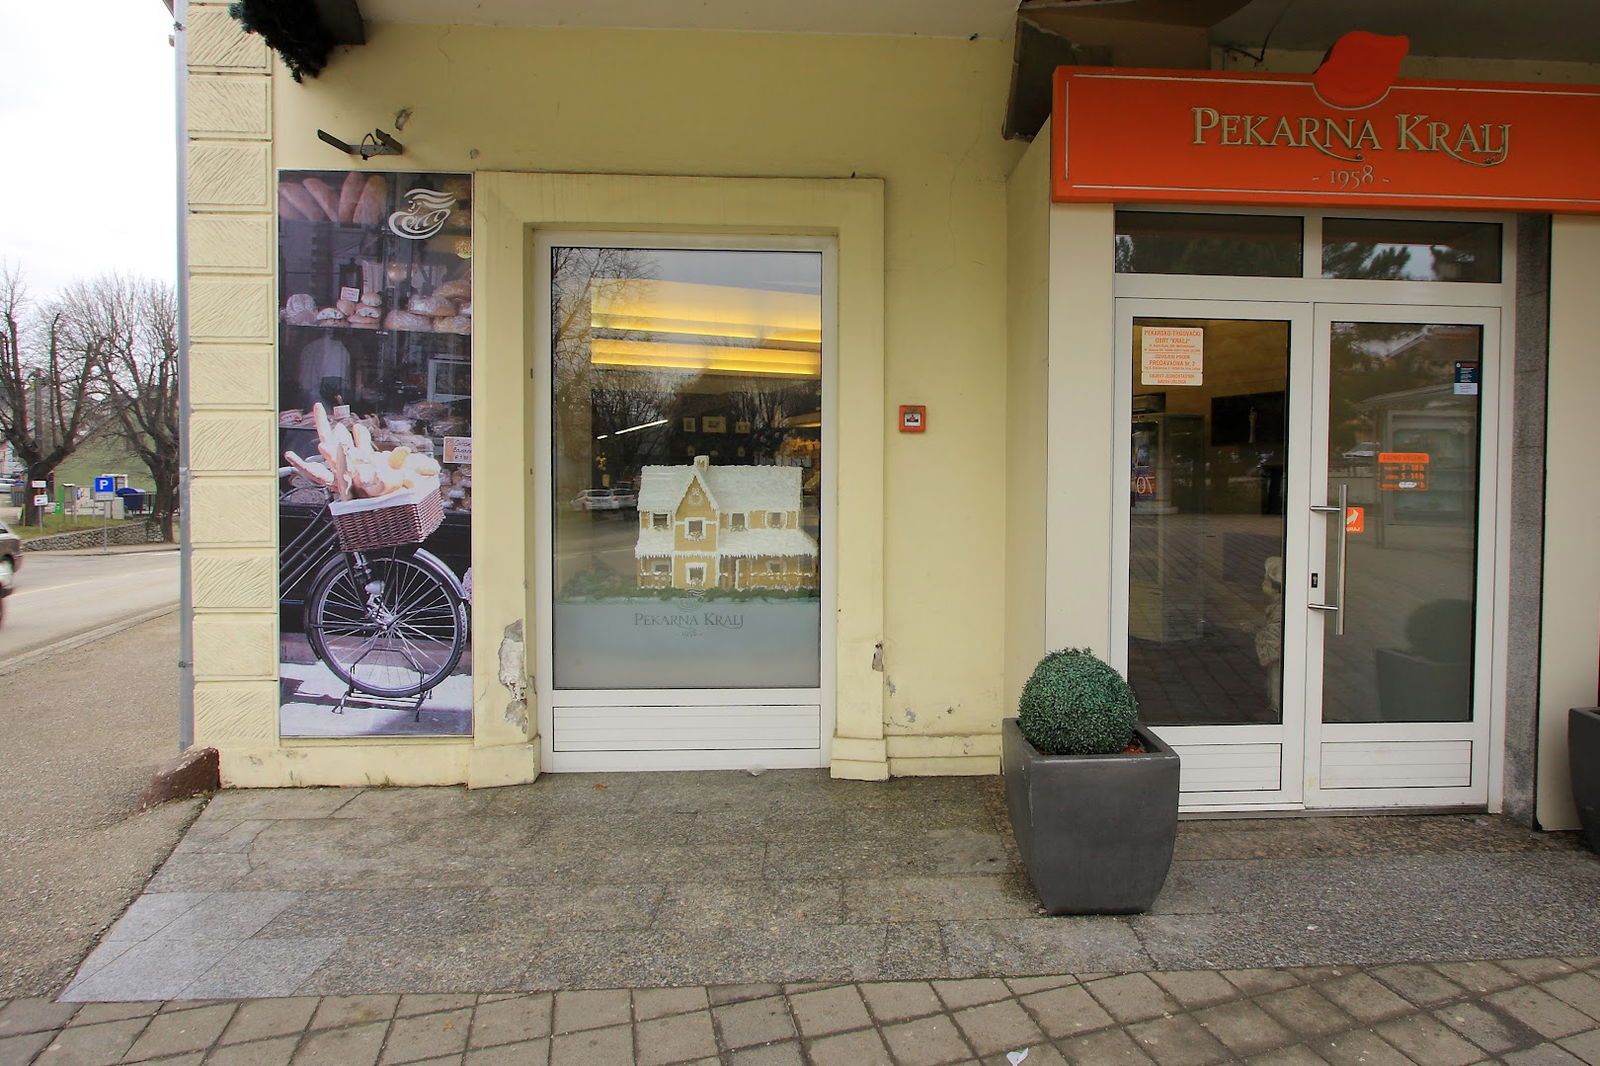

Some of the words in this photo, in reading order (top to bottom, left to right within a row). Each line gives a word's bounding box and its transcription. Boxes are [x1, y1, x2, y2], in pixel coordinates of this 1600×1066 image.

[1191, 107, 1383, 162] PEKARNA
[1395, 113, 1512, 167] KRALJ
[1329, 164, 1375, 190] 1958
[99, 479, 109, 490] P
[634, 612, 699, 630] PEKARNA
[704, 612, 744, 630] KRALJ
